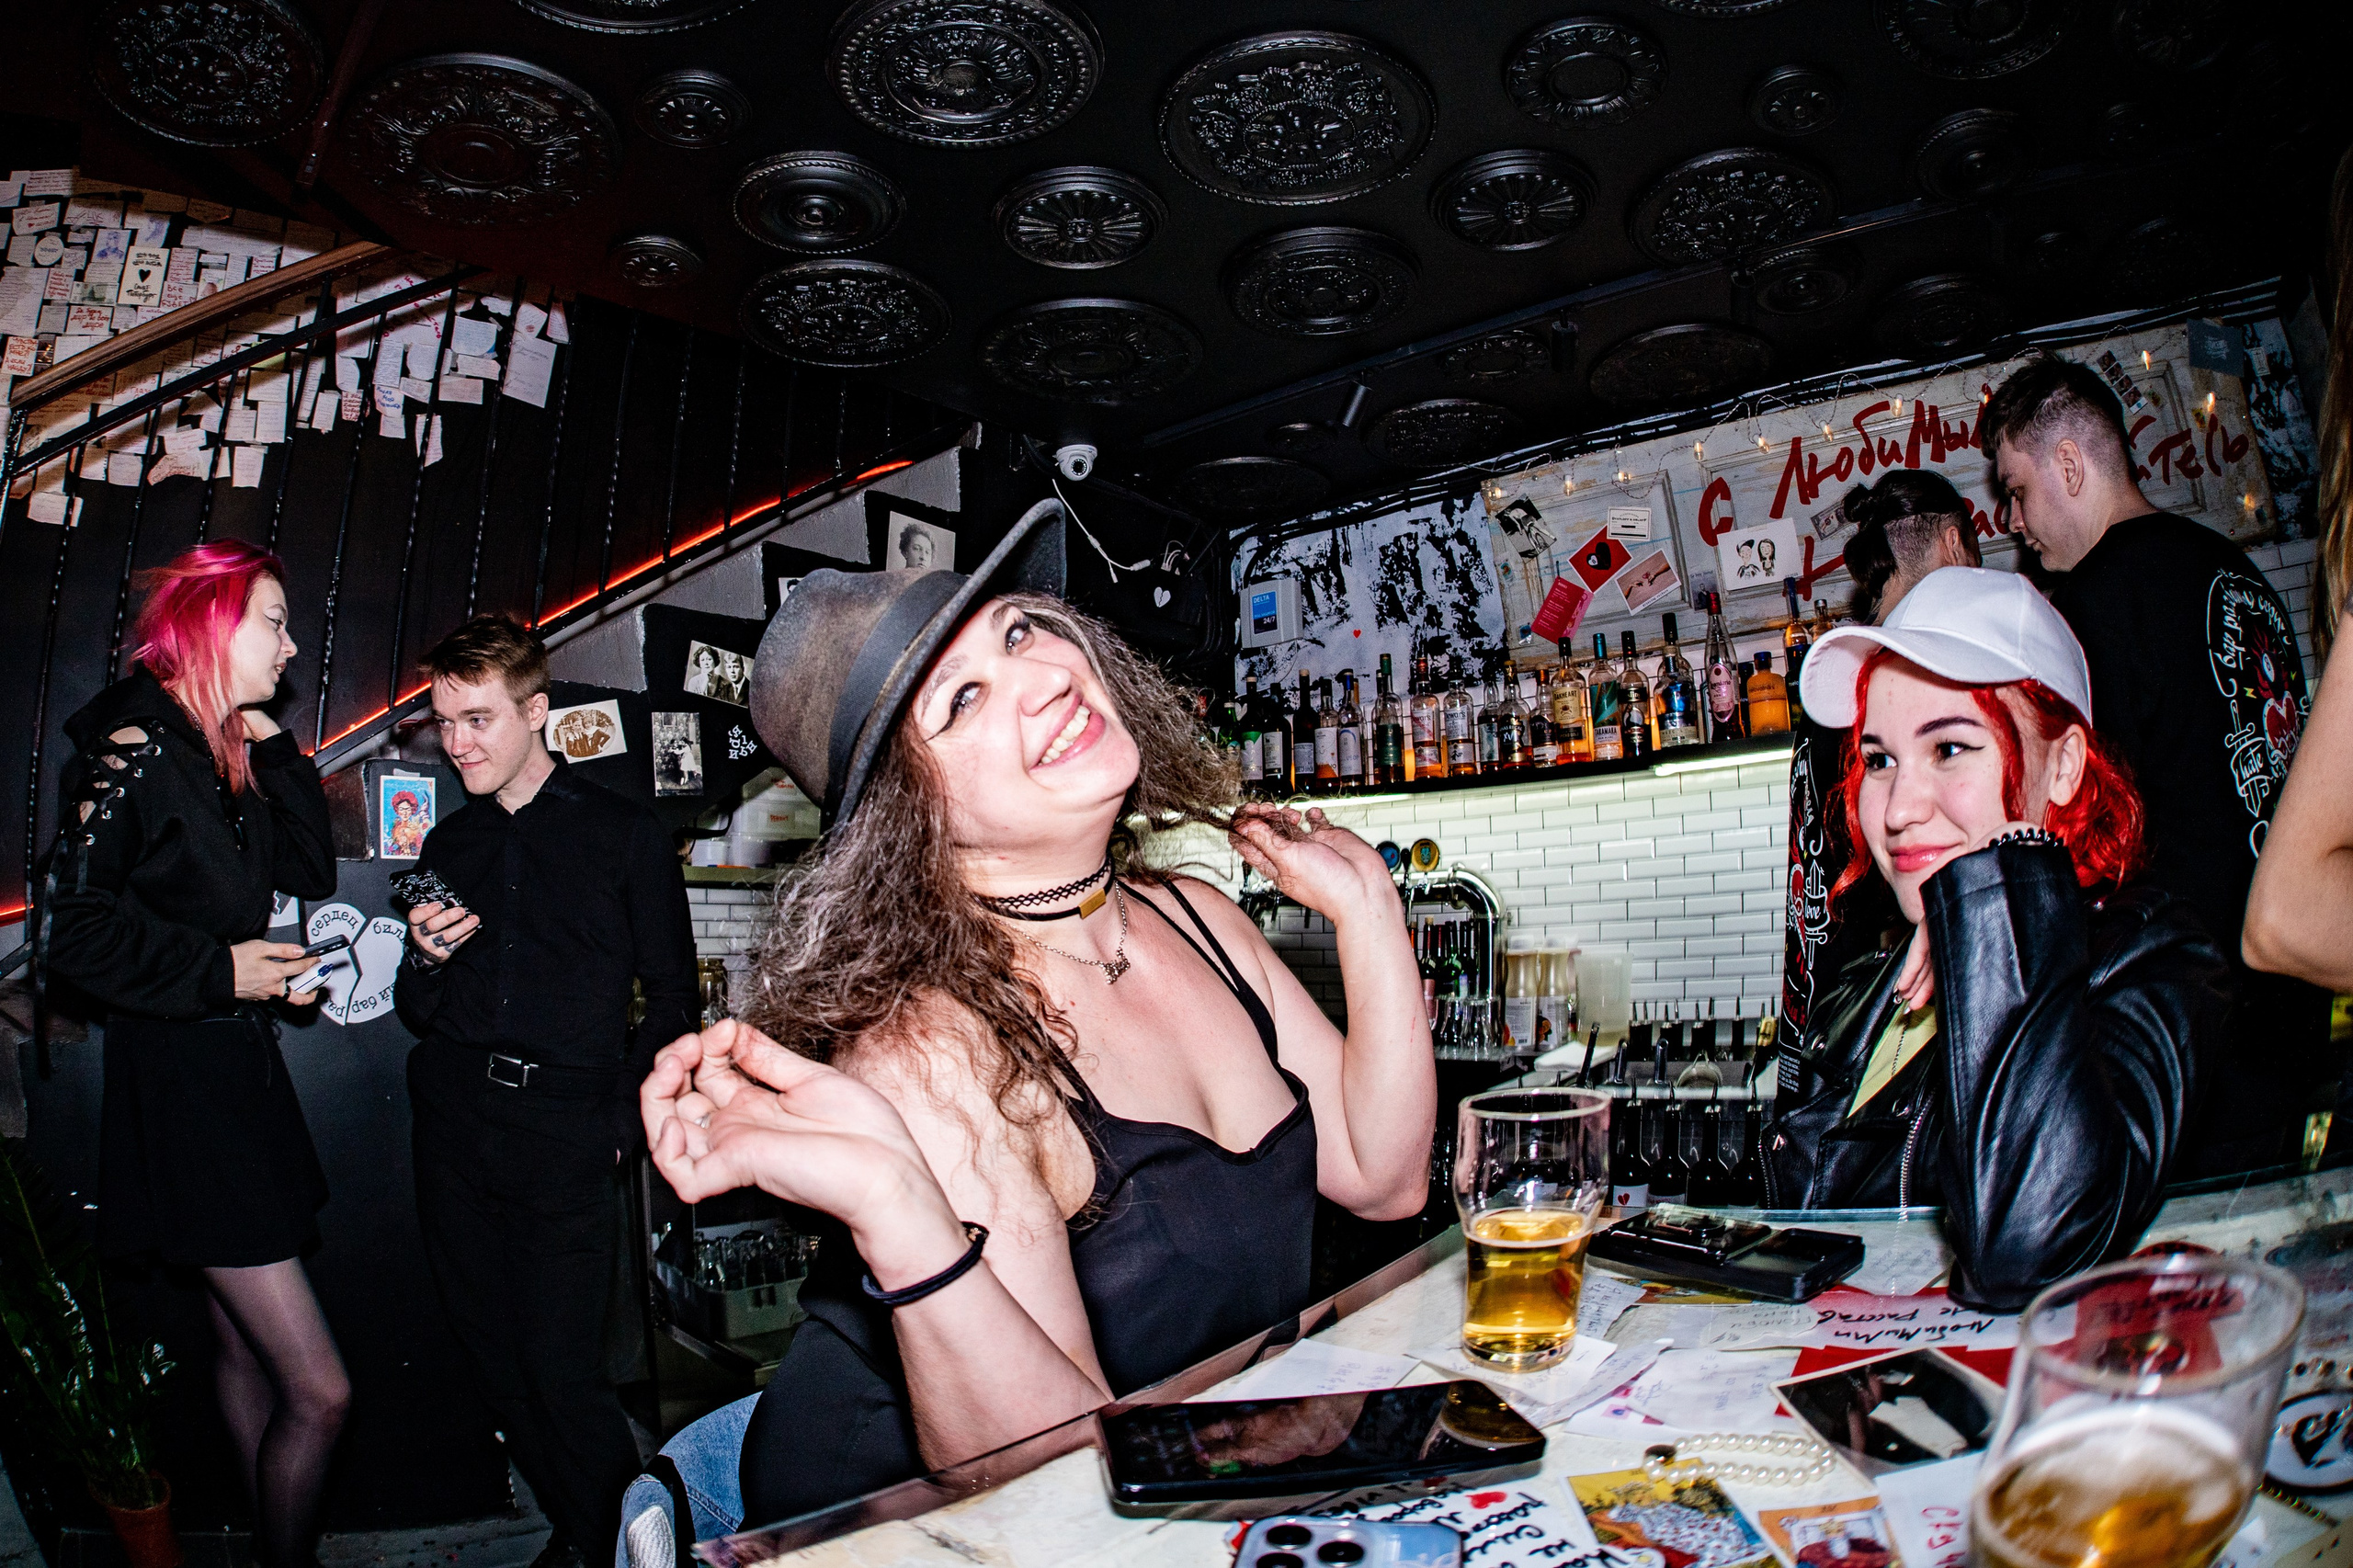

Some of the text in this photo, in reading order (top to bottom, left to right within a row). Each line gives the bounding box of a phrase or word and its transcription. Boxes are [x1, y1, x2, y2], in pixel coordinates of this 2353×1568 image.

[1253, 594, 1270, 605] DELTA
[1263, 615, 1276, 624] 24/7
[2239, 740, 2265, 780] hate
[1804, 895, 1822, 920] love
[311, 910, 359, 937] сердец
[351, 996, 378, 1014] бар
